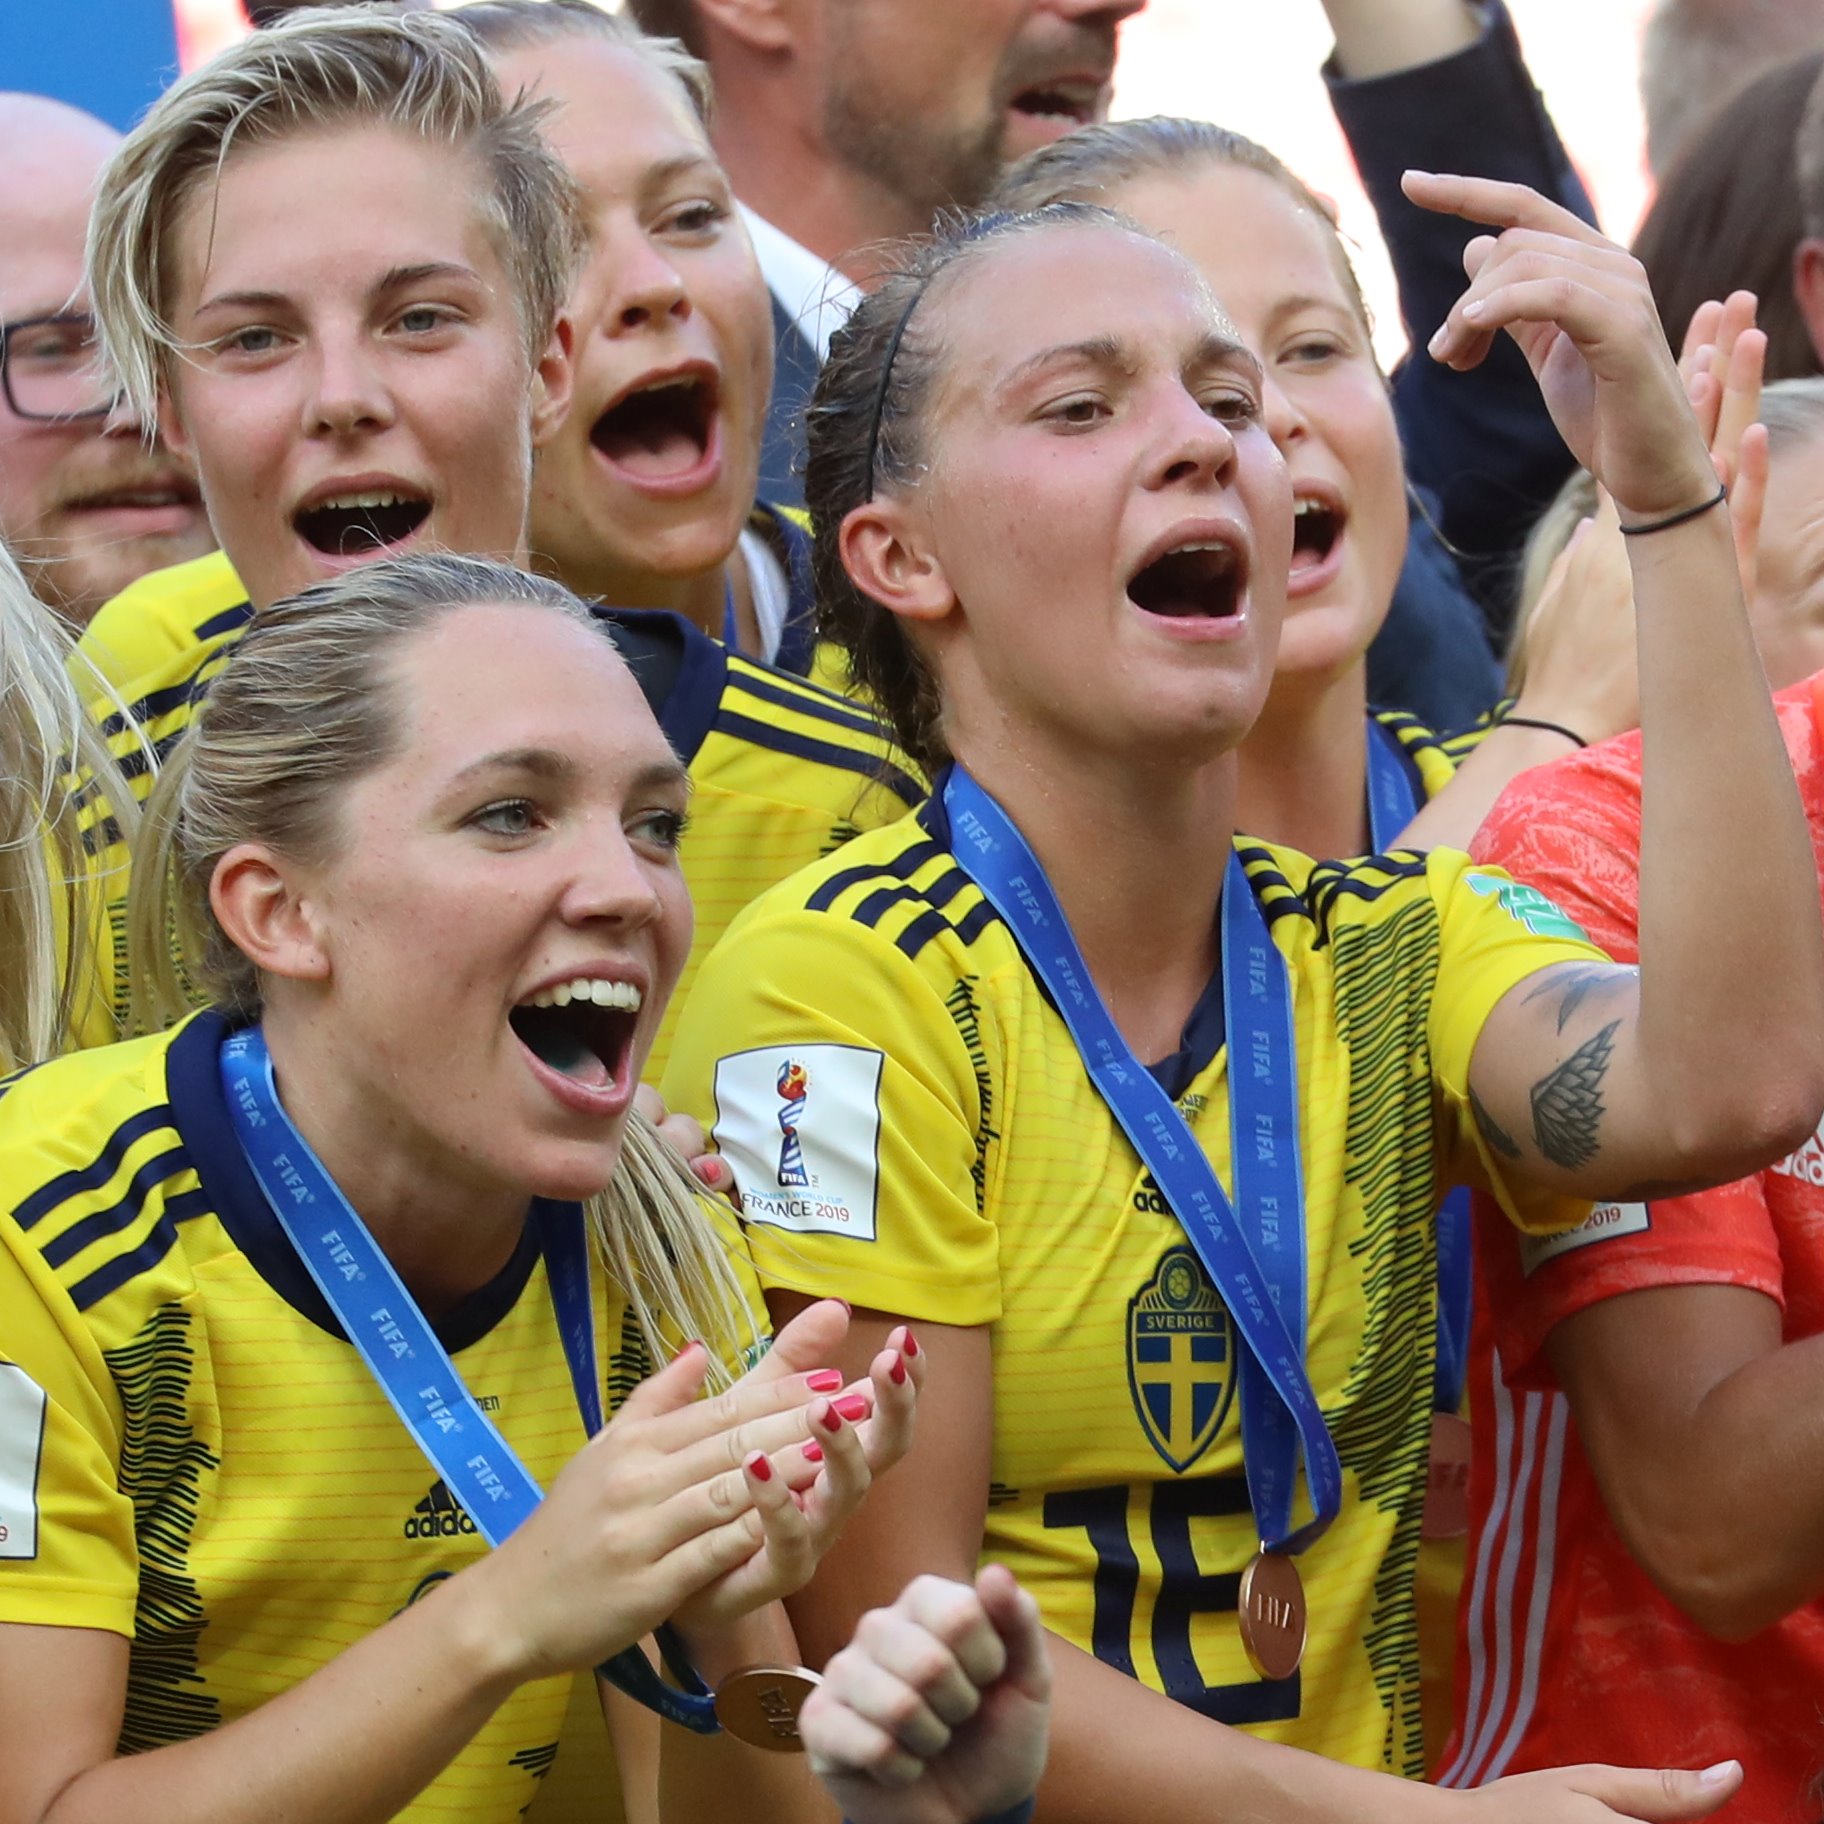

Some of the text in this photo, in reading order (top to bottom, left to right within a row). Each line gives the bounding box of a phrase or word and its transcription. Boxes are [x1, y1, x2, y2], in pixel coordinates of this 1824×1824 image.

[1248, 946, 1267, 997] FIFA
[1252, 1030, 1270, 1078] FIFA
[956, 811, 994, 853] FIFA
[1008, 876, 1044, 925] FIFA
[1055, 956, 1085, 1006] FIFA
[1096, 1039, 1132, 1084] FIFA
[1144, 1112, 1179, 1161] FIFA
[1191, 1191, 1229, 1241] FIFA
[1234, 1273, 1265, 1324] FIFA
[1277, 1357, 1307, 1406] FIFA
[781, 1174, 806, 1185] FIFA
[741, 1193, 850, 1222] FRANCE 2019
[1260, 1196, 1278, 1246] FIFA
[1583, 1206, 1621, 1230] 2019
[232, 1077, 260, 1126] FIFA
[273, 1153, 306, 1202] FIFA
[321, 1231, 357, 1280] FIFA
[371, 1308, 408, 1358] FIFA
[417, 1386, 457, 1433] FIFA
[467, 1454, 504, 1501] FIFA
[1147, 1313, 1216, 1330] SVERIGE
[405, 1509, 476, 1539] adida
